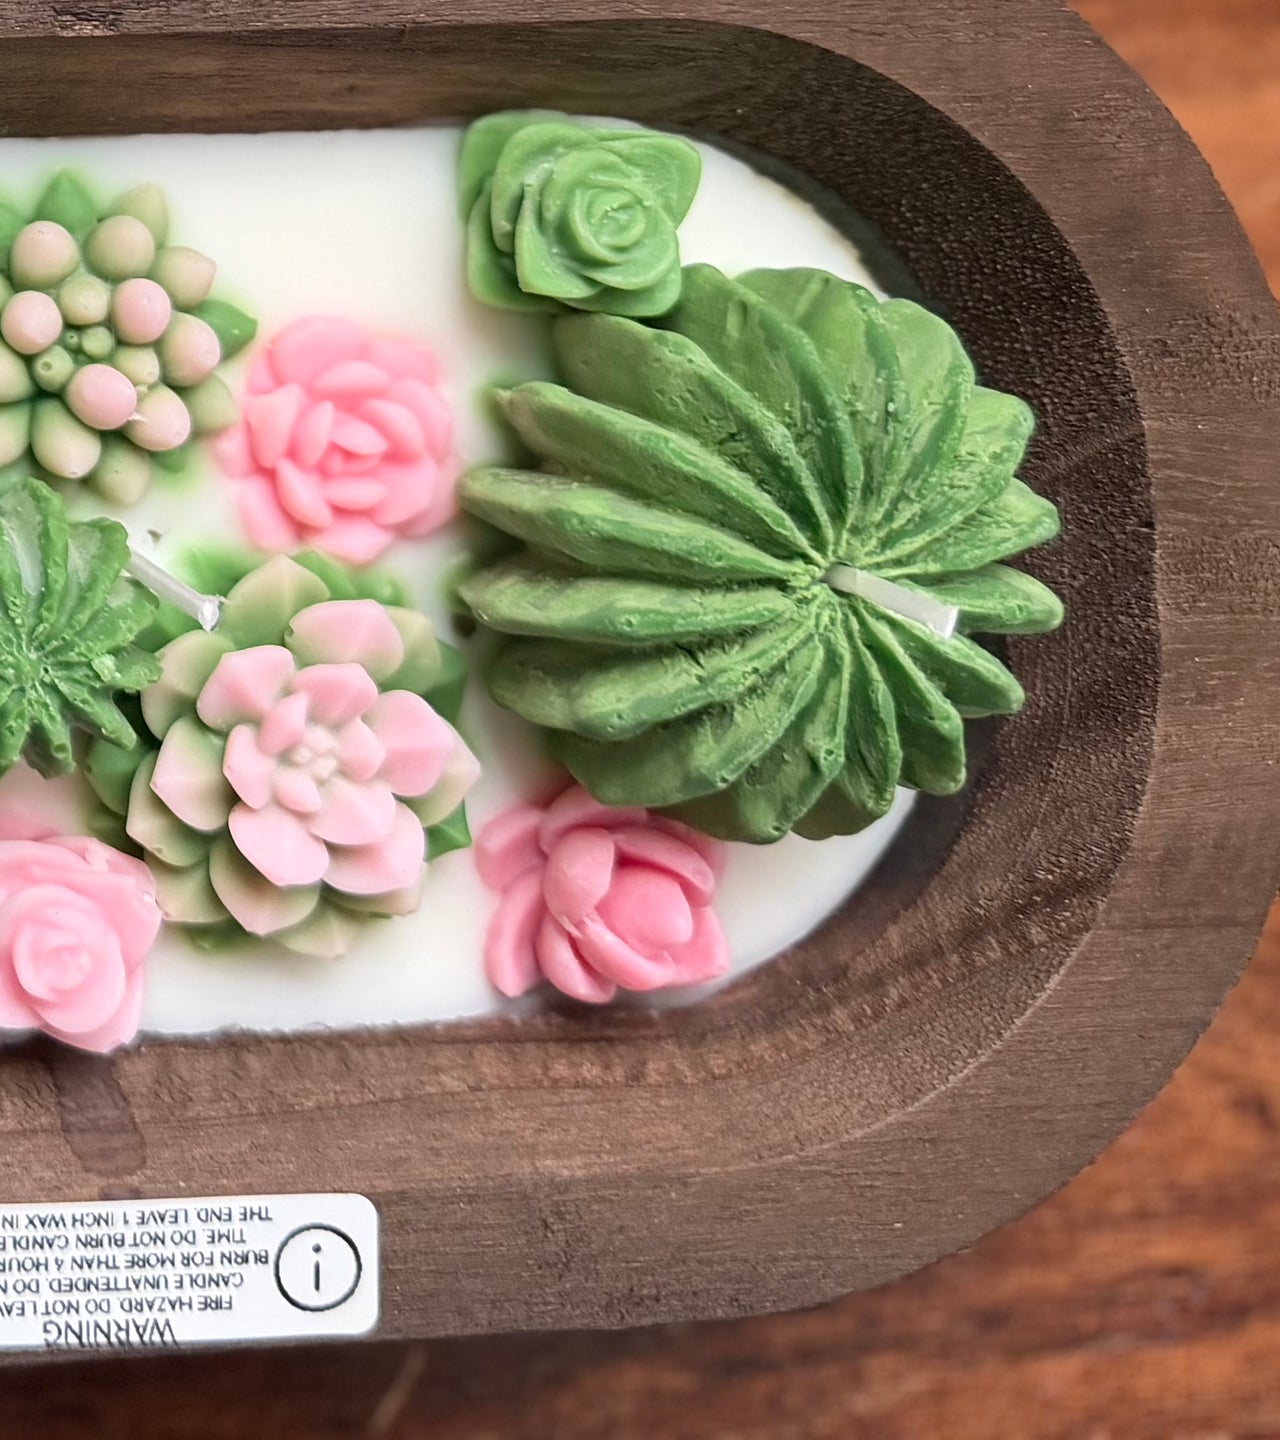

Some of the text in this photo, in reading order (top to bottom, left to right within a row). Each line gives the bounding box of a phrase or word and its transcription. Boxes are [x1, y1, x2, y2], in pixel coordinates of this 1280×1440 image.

[1, 1212, 19, 1229] IN
[25, 1211, 67, 1228] WAX
[71, 1210, 115, 1227] INCH
[122, 1210, 130, 1226] 1
[135, 1208, 189, 1226] LEAVE
[194, 1207, 233, 1225] END.
[238, 1207, 273, 1224] THE
[75, 1232, 125, 1249] BURN
[128, 1231, 166, 1248] NOT
[170, 1230, 197, 1247] DO
[201, 1229, 247, 1246] TIME.
[53, 1254, 65, 1271] 4
[70, 1253, 120, 1271] THAN
[124, 1251, 176, 1269] MORE
[180, 1250, 215, 1268] FOR
[219, 1249, 270, 1267] BURN
[13, 1278, 41, 1295] DO
[45, 1275, 169, 1294] UNATTENDED.
[173, 1273, 244, 1291] CANDLE
[41, 1298, 80, 1316] NOT
[85, 1298, 111, 1315] DO
[116, 1296, 193, 1314] HAZARD.
[196, 1295, 233, 1313] FIRE
[42, 1318, 178, 1349] WARNING
